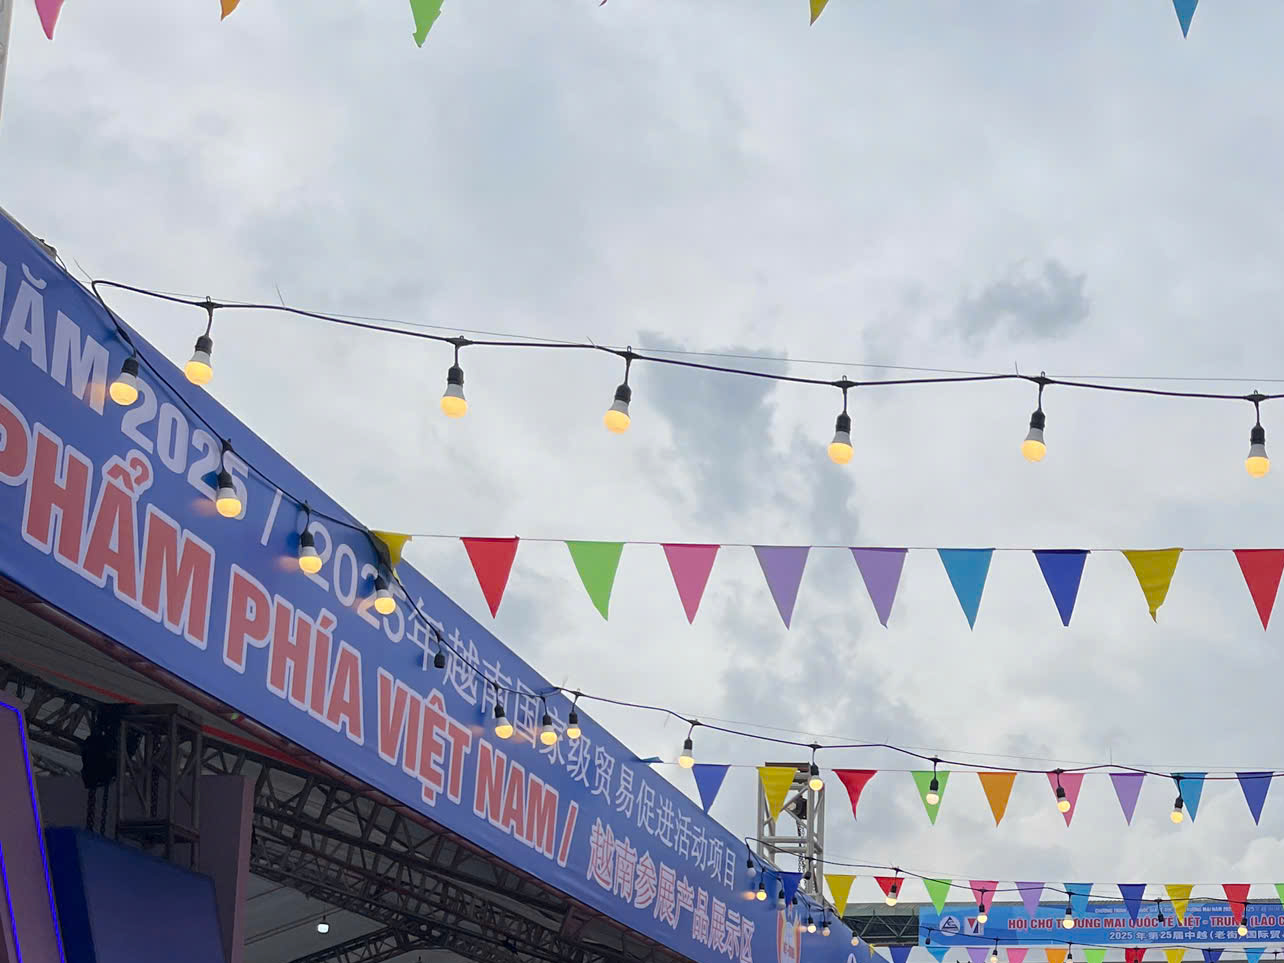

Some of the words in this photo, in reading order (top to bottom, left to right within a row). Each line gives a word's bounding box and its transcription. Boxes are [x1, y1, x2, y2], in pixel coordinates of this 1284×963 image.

[0, 260, 109, 416] ĂM
[120, 377, 249, 520] 2025
[223, 563, 365, 746] PHÍA
[376, 666, 473, 808] VIỆT
[472, 738, 560, 860] NAM
[1007, 916, 1028, 933] HỘI
[1030, 917, 1054, 932] CHỢ
[1055, 918, 1101, 930] TƠNG
[1104, 918, 1126, 933] MẠI
[1210, 917, 1247, 930] TRUN
[1250, 914, 1277, 929] (LÀO
